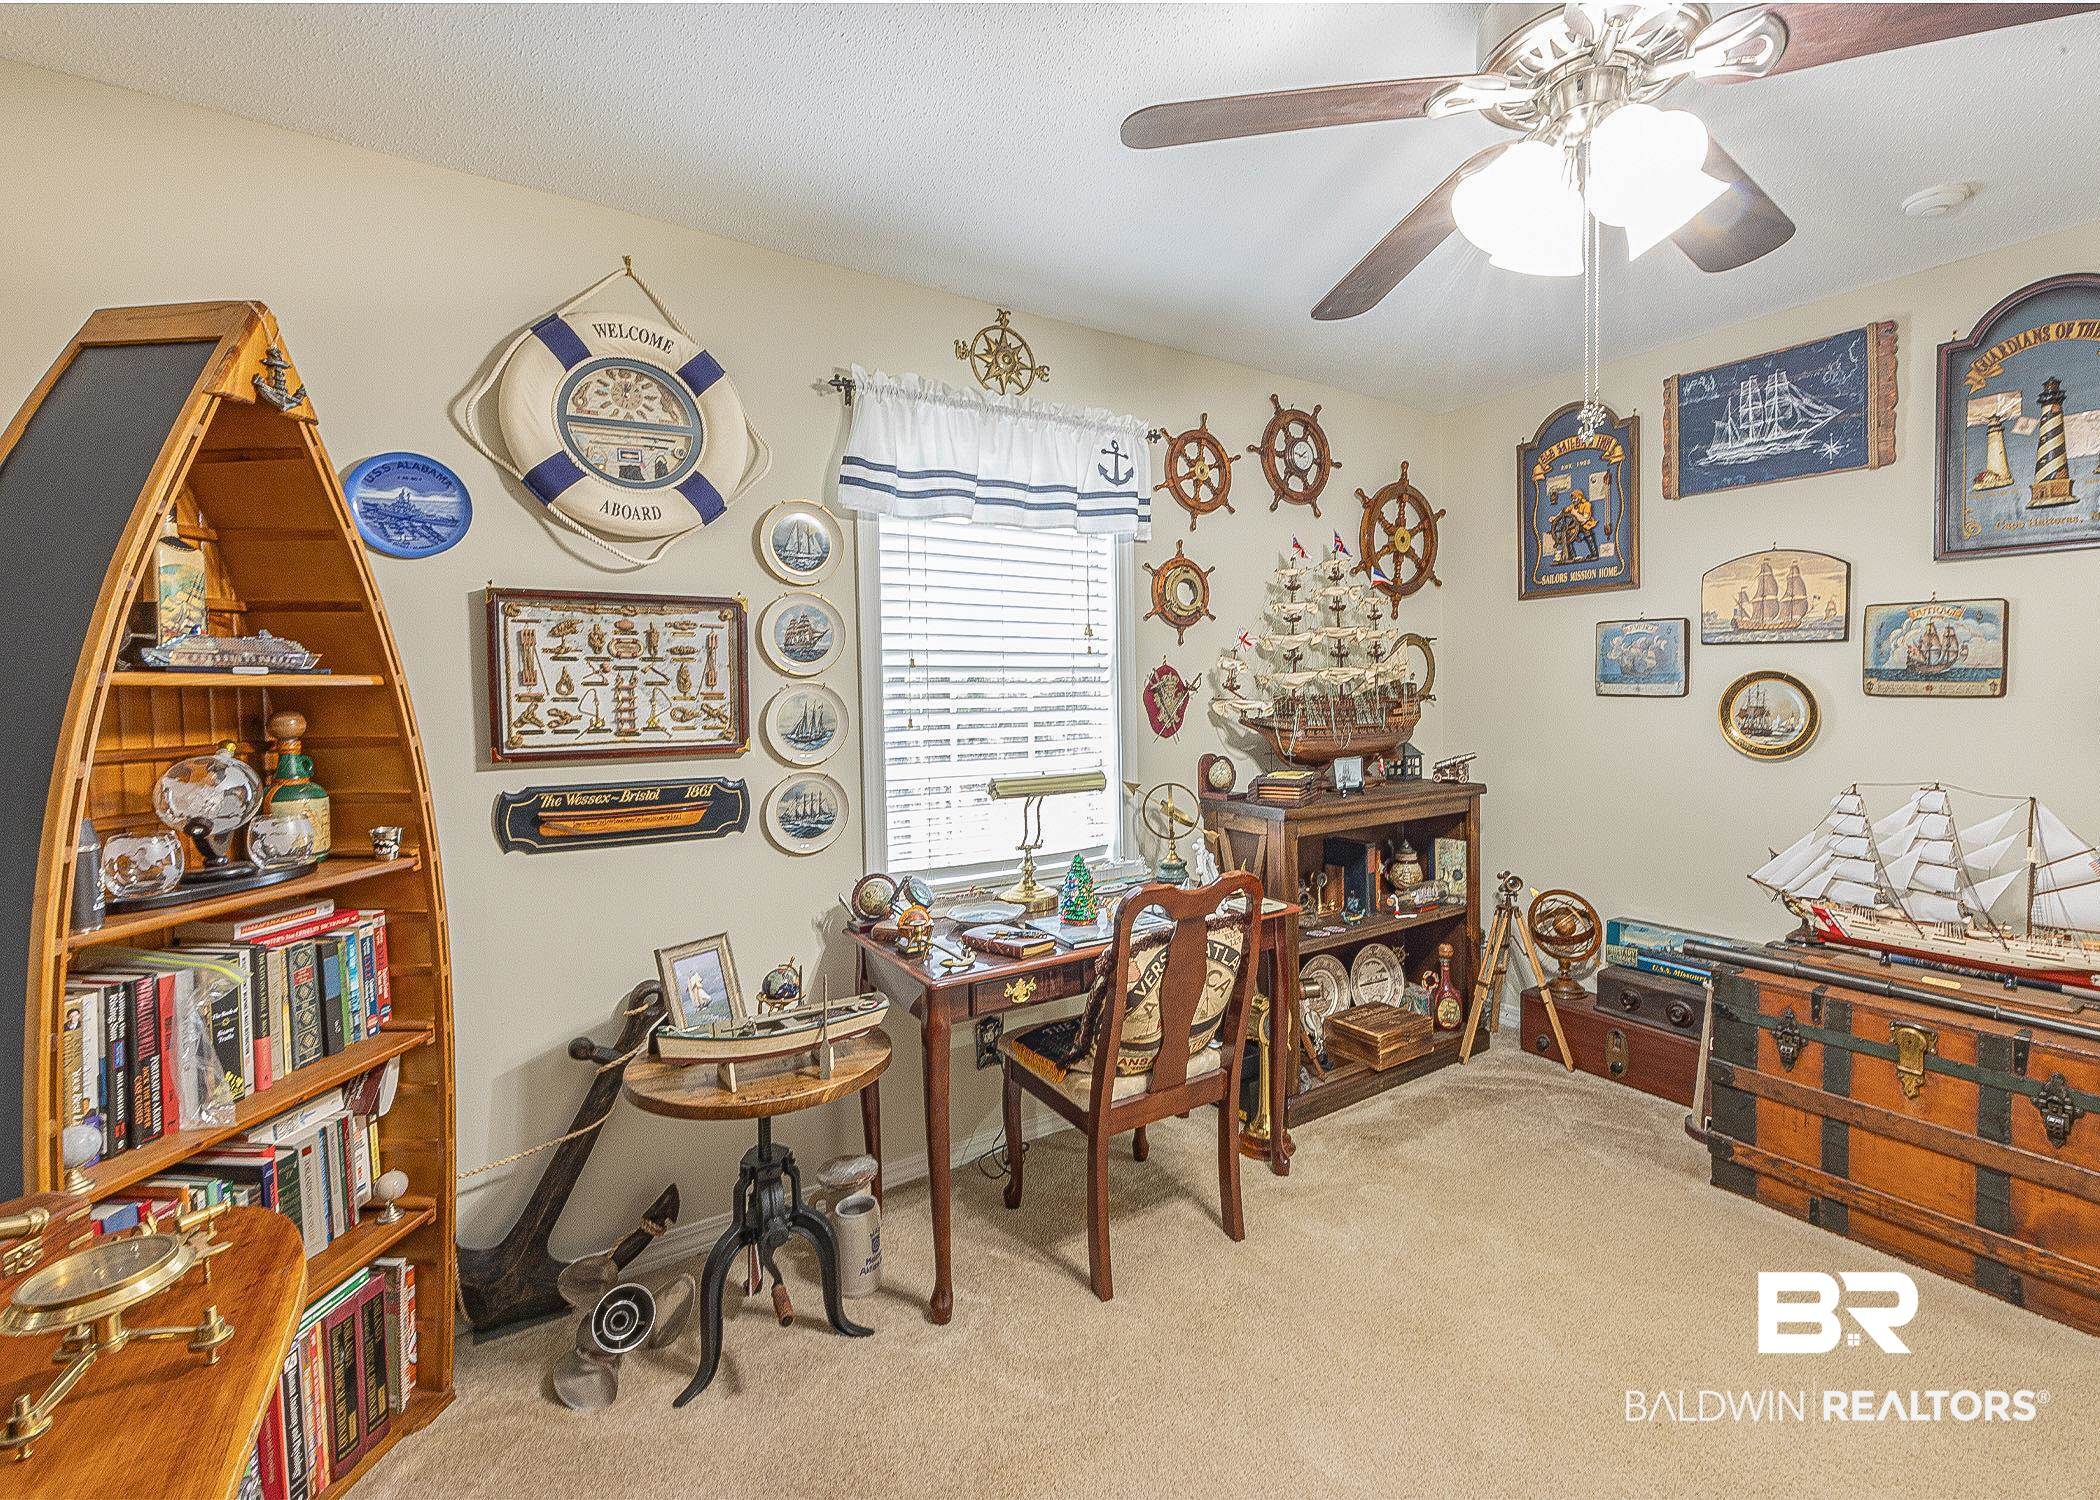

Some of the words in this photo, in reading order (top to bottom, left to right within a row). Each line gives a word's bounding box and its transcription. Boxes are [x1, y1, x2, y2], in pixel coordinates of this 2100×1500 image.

[592, 322, 675, 355] WELCOME
[1973, 324, 2051, 372] GUARDIANS
[2055, 322, 2074, 339] OF
[397, 461, 452, 488] ALABAMA
[599, 499, 662, 521] ABOARD
[1570, 568, 1597, 582] MISSION
[1599, 566, 1618, 578] HOME
[540, 793, 562, 808] The
[683, 783, 714, 799] 1861
[108, 993, 119, 1022] Rising
[117, 991, 126, 1017] Killing
[150, 1055, 160, 1093] PORTRAIT
[152, 1107, 162, 1135] KILLER
[287, 1366, 297, 1398] Human
[289, 1393, 300, 1429] Anatomy
[291, 1436, 304, 1480] Physiology
